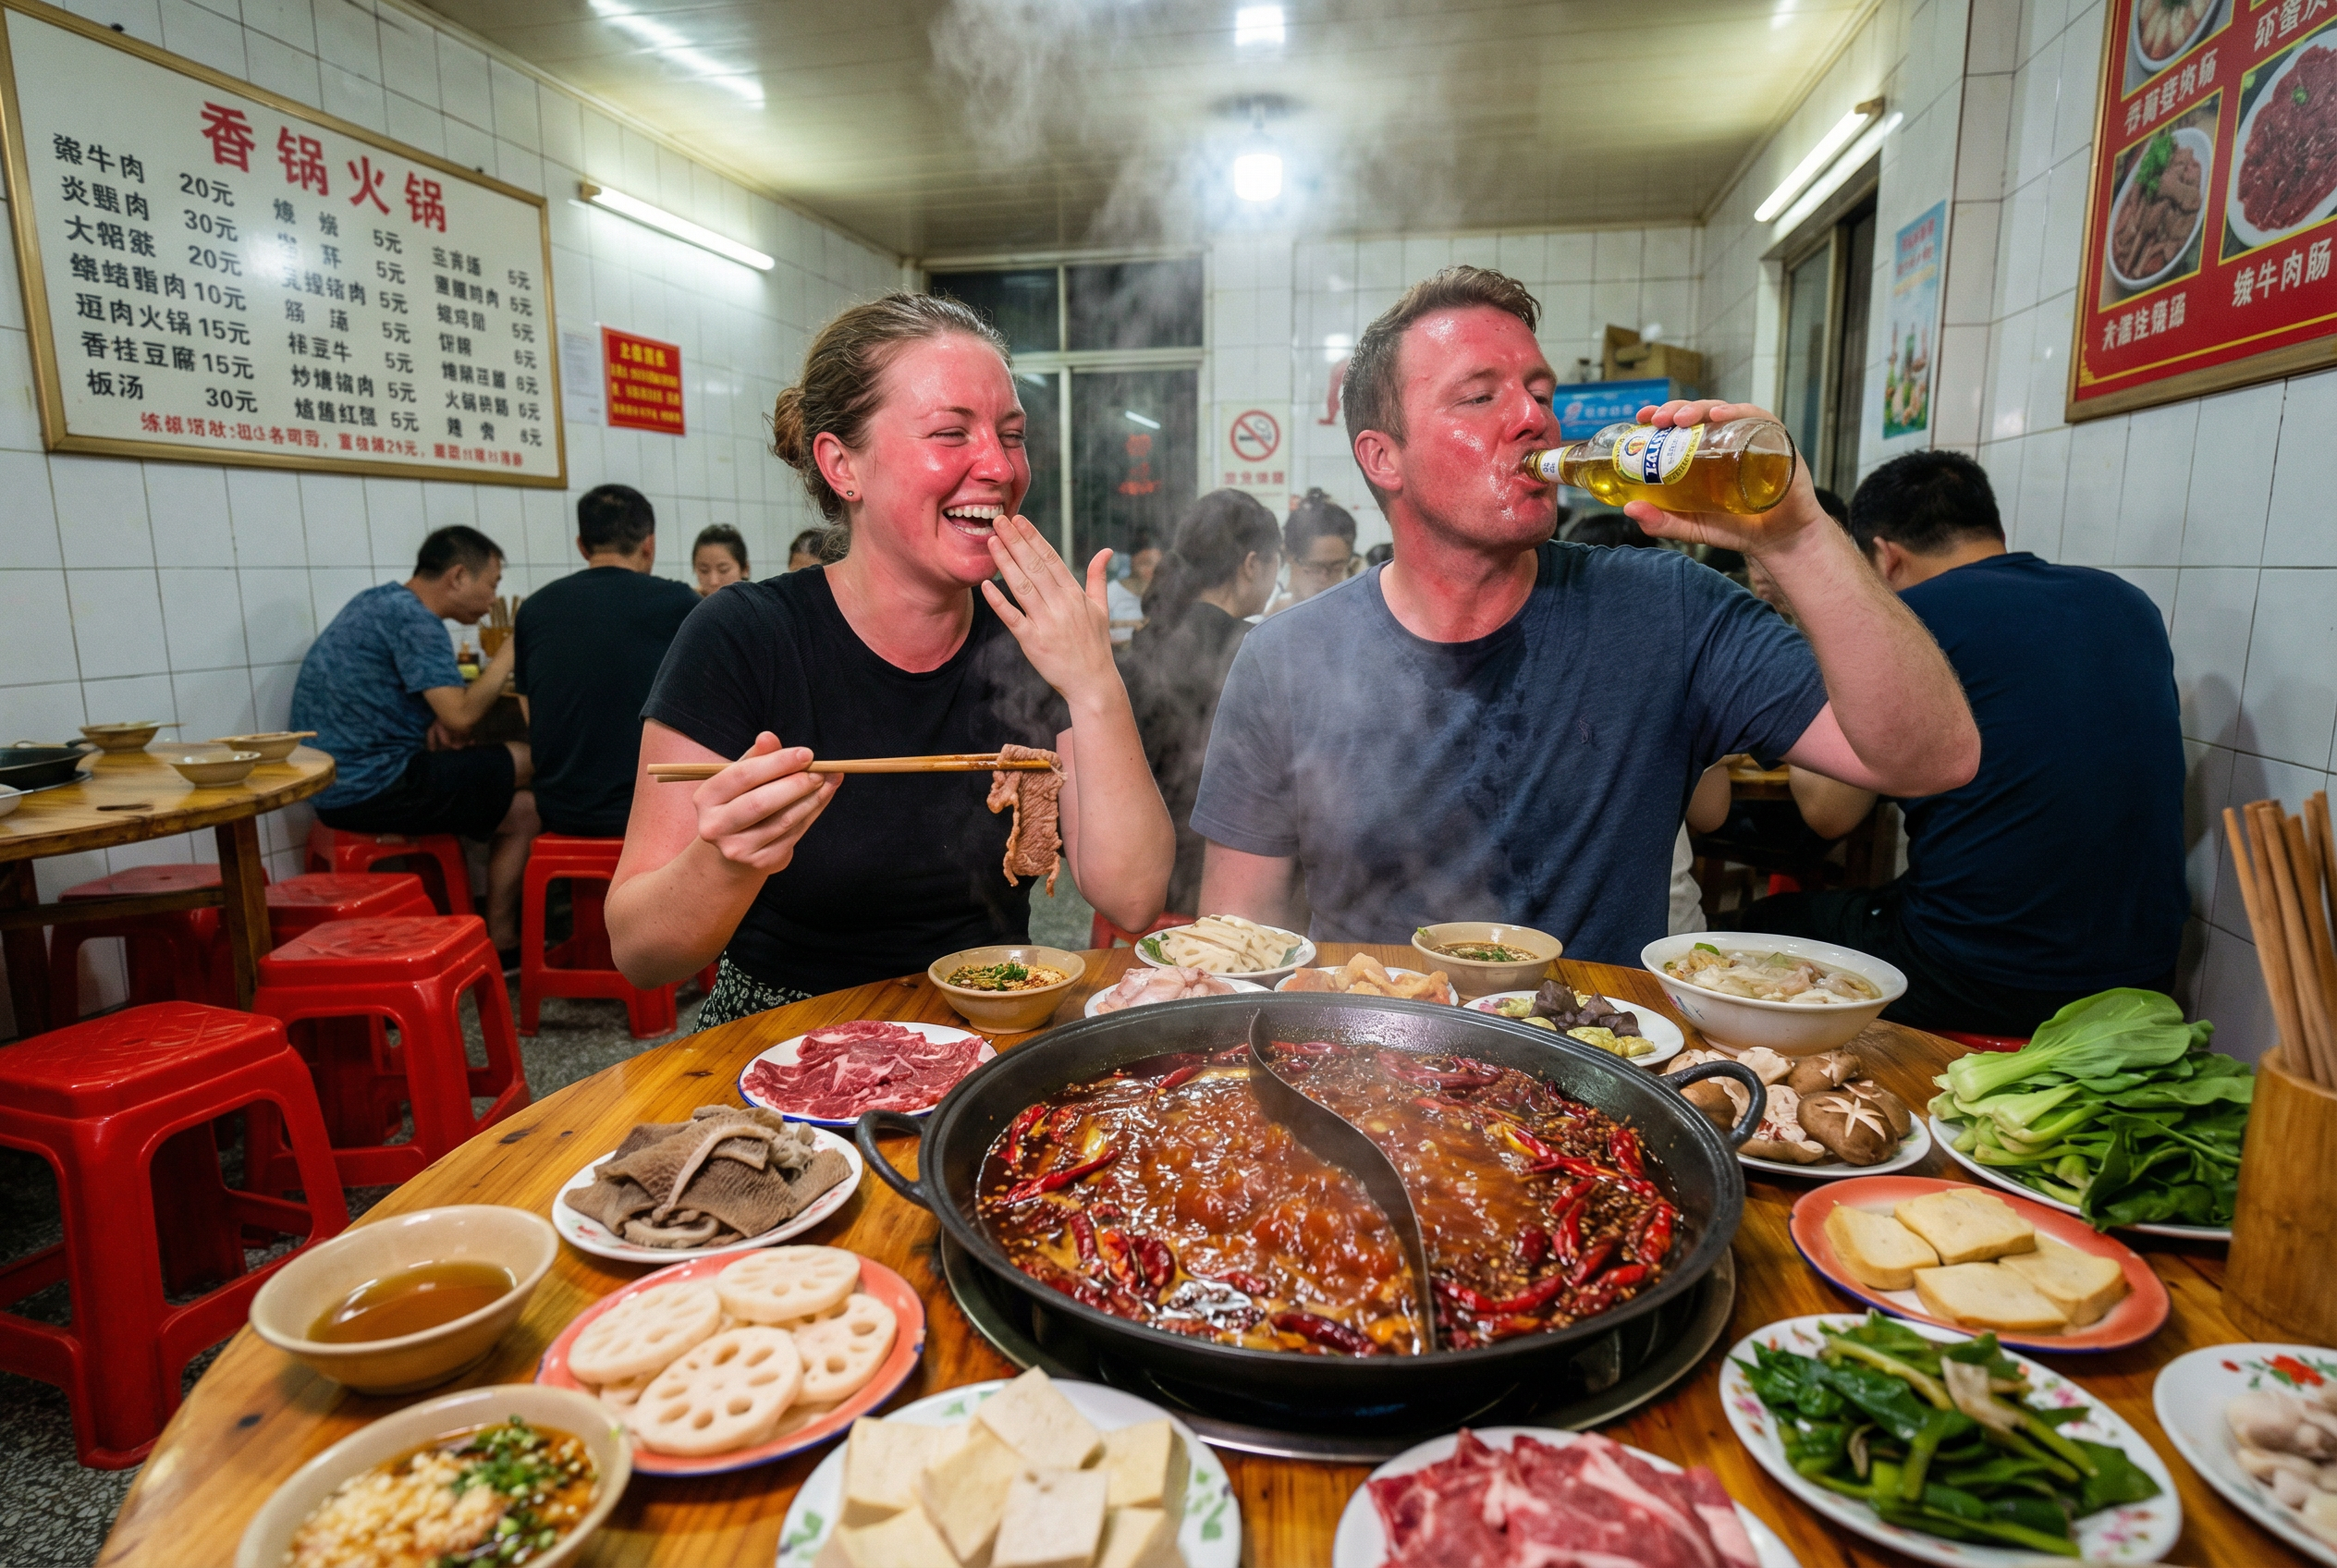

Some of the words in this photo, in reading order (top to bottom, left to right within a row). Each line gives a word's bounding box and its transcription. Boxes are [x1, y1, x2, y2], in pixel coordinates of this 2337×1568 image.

[200, 100, 447, 233] 香锅火锅
[179, 172, 235, 208] 20元
[184, 209, 239, 242] 30元
[373, 229, 402, 254] 5元
[188, 245, 242, 277] 20元
[376, 260, 406, 285] 5元
[508, 269, 531, 290] 5元
[194, 282, 247, 312] 10元
[379, 290, 408, 314] 5元
[510, 297, 532, 316] 5元
[198, 318, 251, 346] 15元
[382, 322, 410, 344] 5元
[511, 323, 534, 343] 5元
[202, 353, 254, 380] 15元
[385, 352, 413, 374] 5元
[86, 369, 144, 400] 板汤
[205, 387, 258, 413] 30元
[387, 382, 417, 403] 5元
[391, 411, 420, 432] 5元
